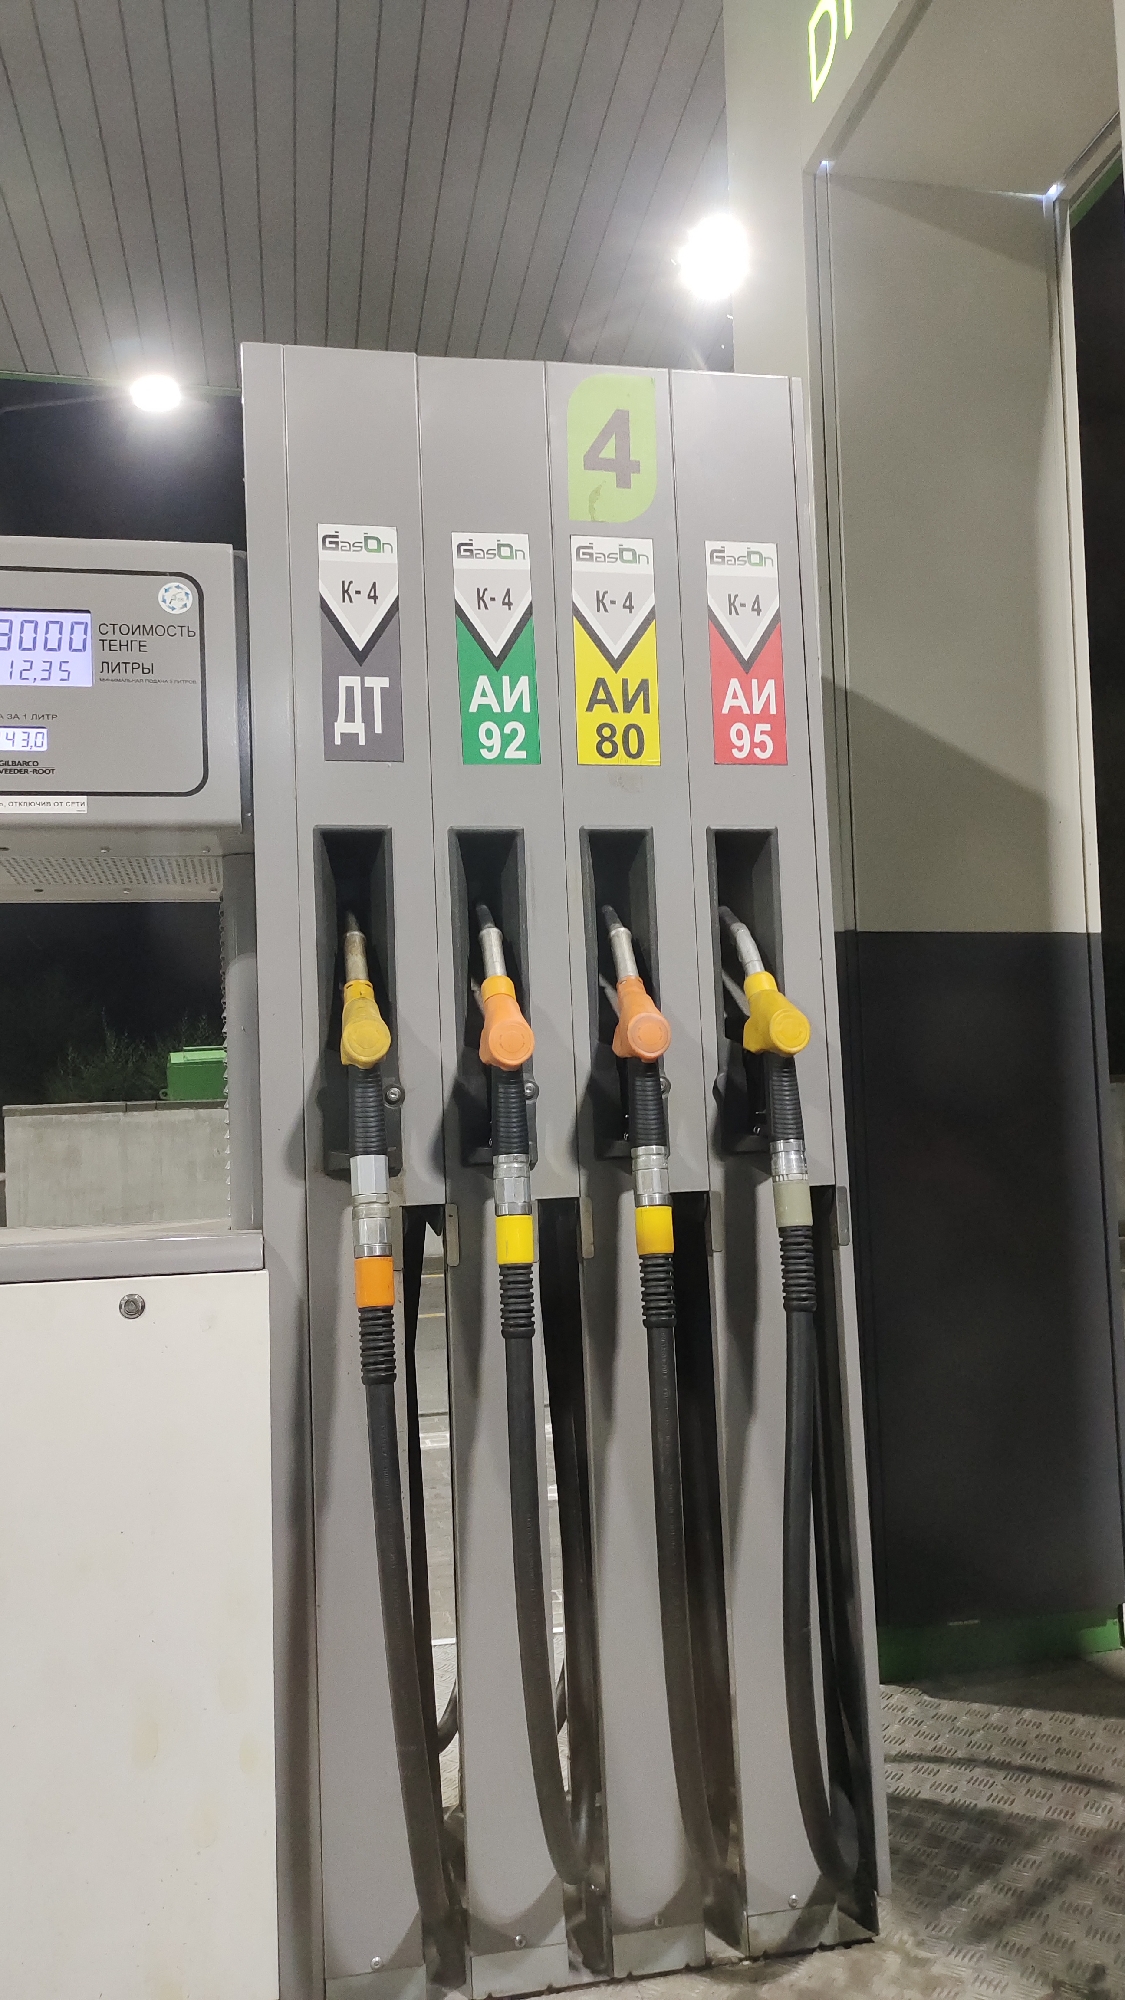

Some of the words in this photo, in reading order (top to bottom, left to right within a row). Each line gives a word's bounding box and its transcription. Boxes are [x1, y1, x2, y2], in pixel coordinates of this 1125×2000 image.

[583, 409, 640, 489] 4
[322, 531, 393, 553] GasOn
[456, 538, 526, 560] GasOn
[576, 543, 649, 565] GasOn
[710, 546, 774, 567] GasOn
[98, 623, 196, 637] СТОИМОСТЬ
[99, 639, 148, 652] ТЕНГЕ
[9, 660, 71, 683] 12,35
[100, 661, 154, 675] ЛИТРЫ
[469, 675, 531, 713] АИ
[585, 677, 650, 714] АИ
[721, 678, 777, 715] АИ
[334, 676, 389, 746] ДТ
[478, 721, 527, 760] 92
[595, 723, 645, 759] 80
[730, 722, 774, 760] 95
